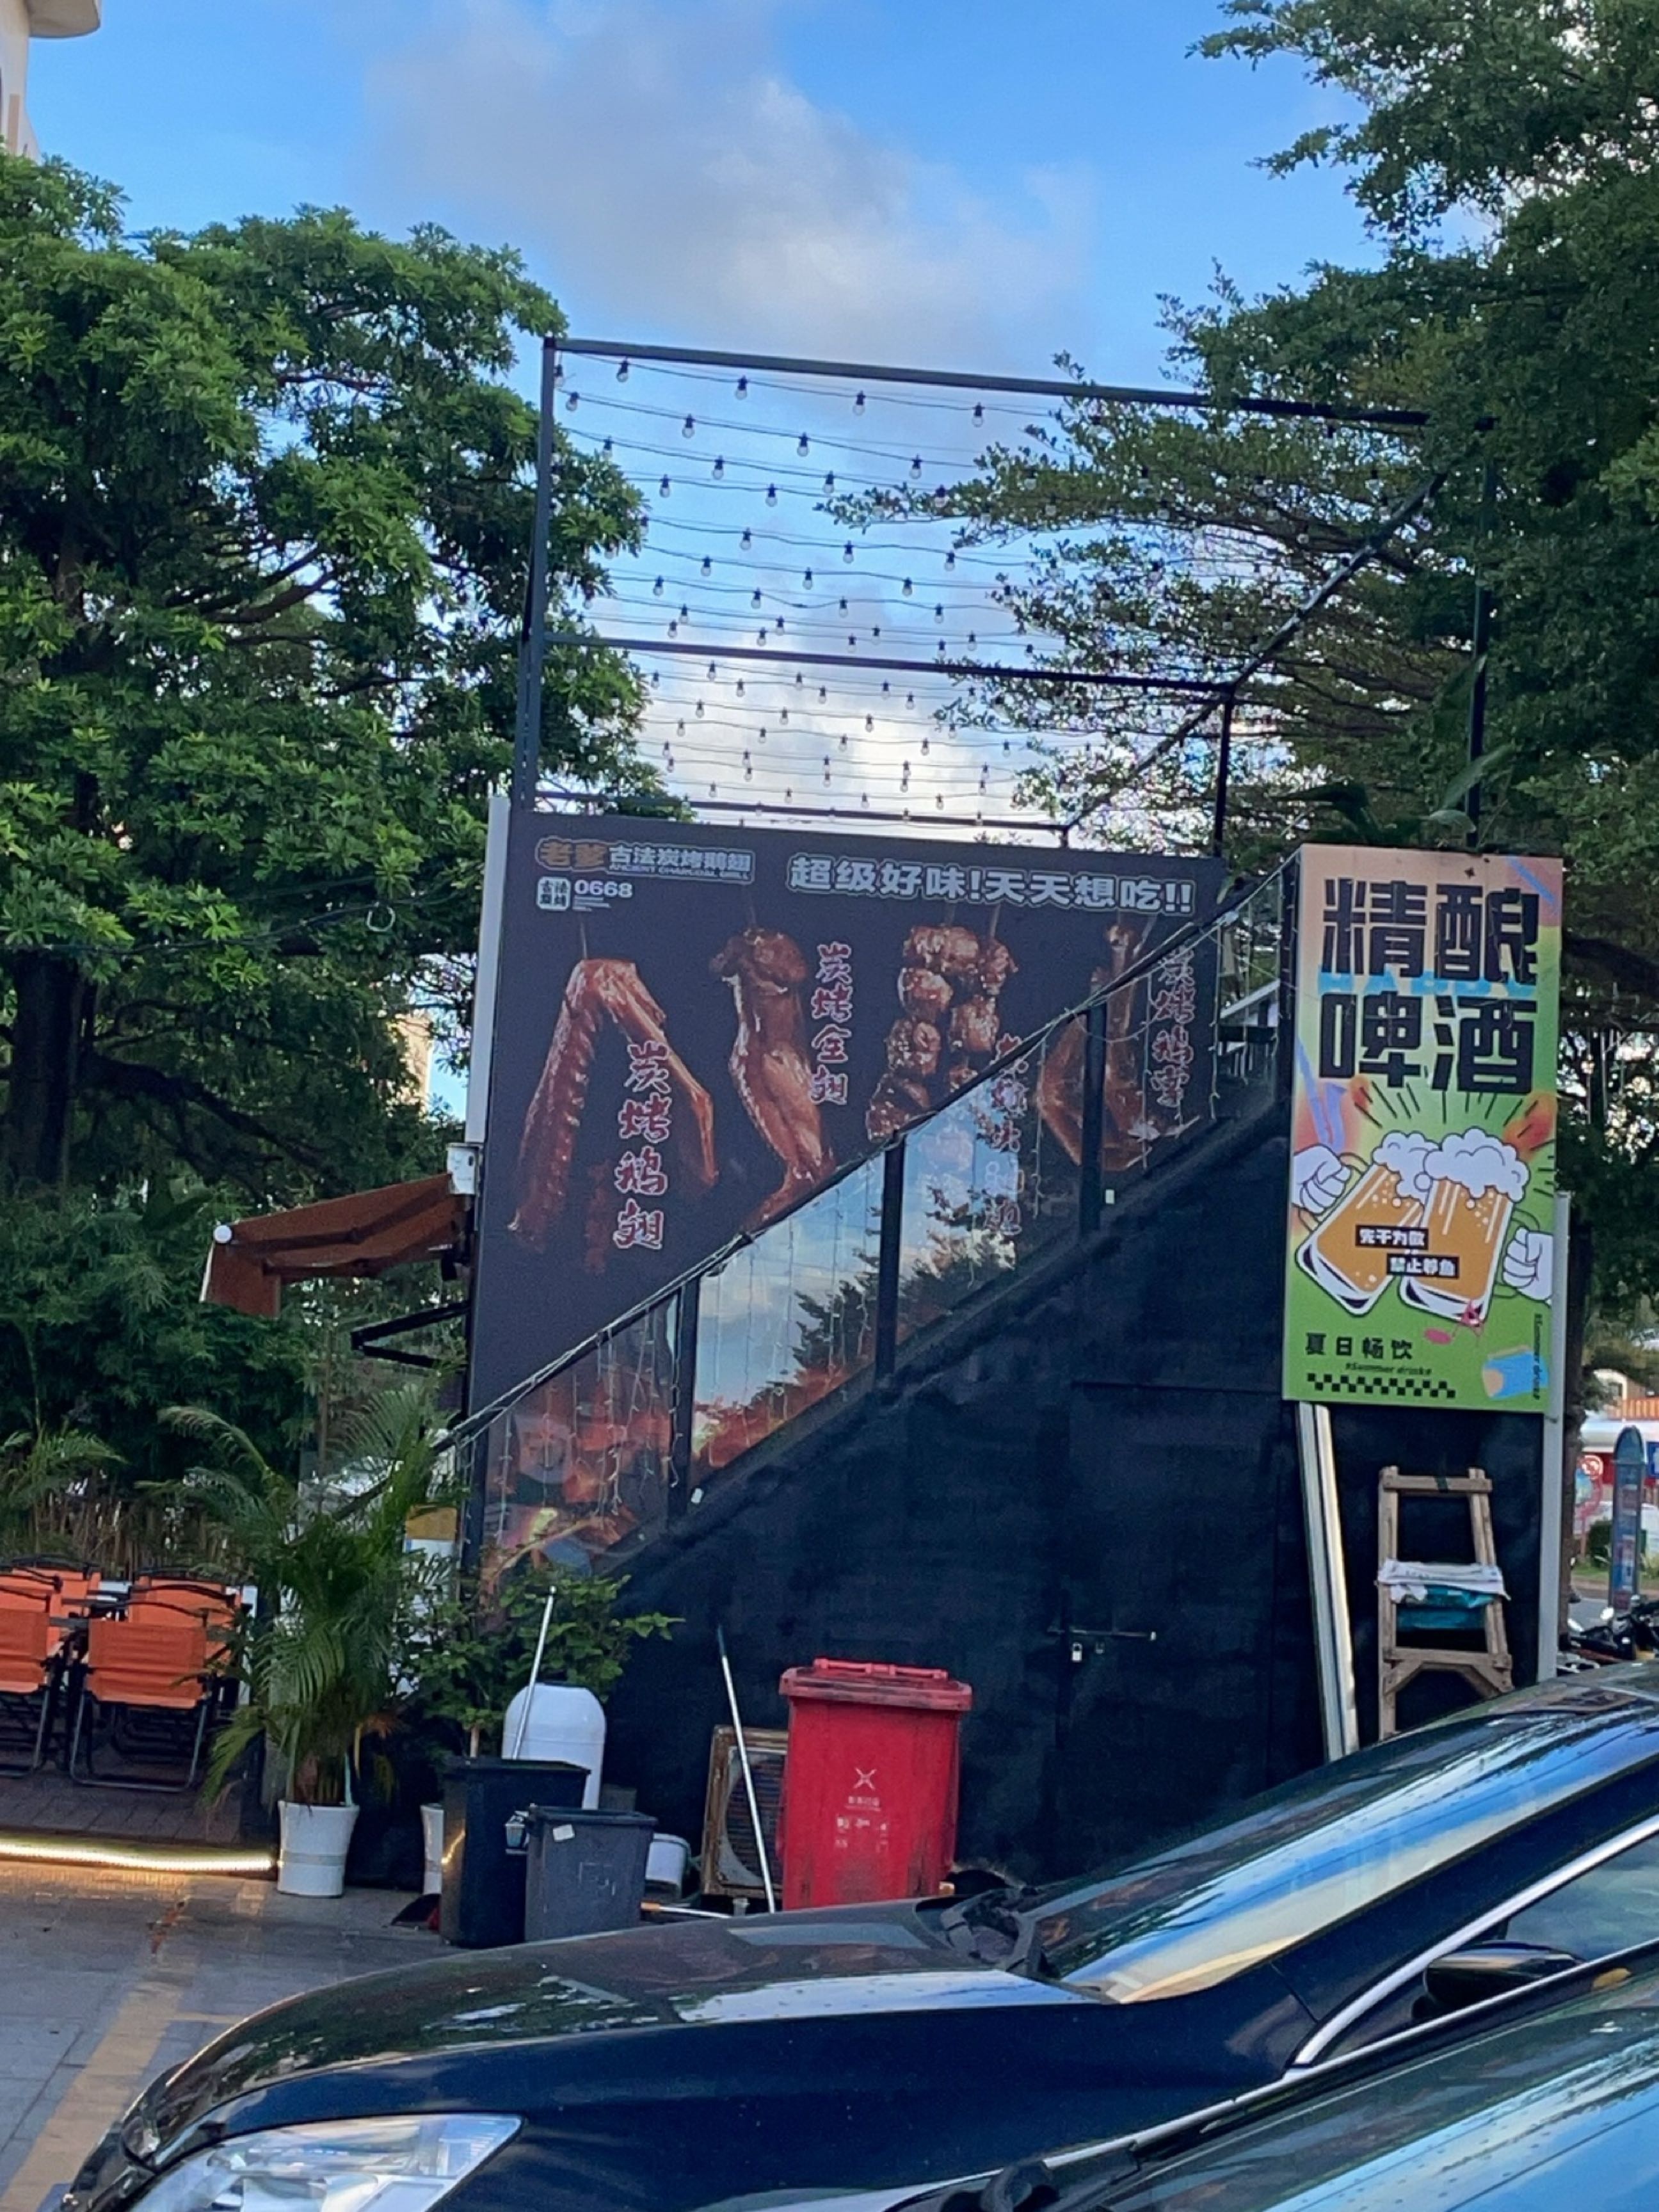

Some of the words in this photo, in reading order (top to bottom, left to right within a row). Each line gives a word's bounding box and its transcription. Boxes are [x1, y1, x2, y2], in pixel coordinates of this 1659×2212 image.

[575, 879, 633, 898] 0668
[789, 855, 1193, 913] 超级好味!天天想吃!!
[1322, 877, 1539, 985] 精酿
[809, 941, 853, 1106] 炭烤全翅
[1318, 990, 1537, 1094] 啤酒
[613, 1041, 672, 1250] 炭烤鹅翅
[1306, 1333, 1413, 1360] 夏日畅饮
